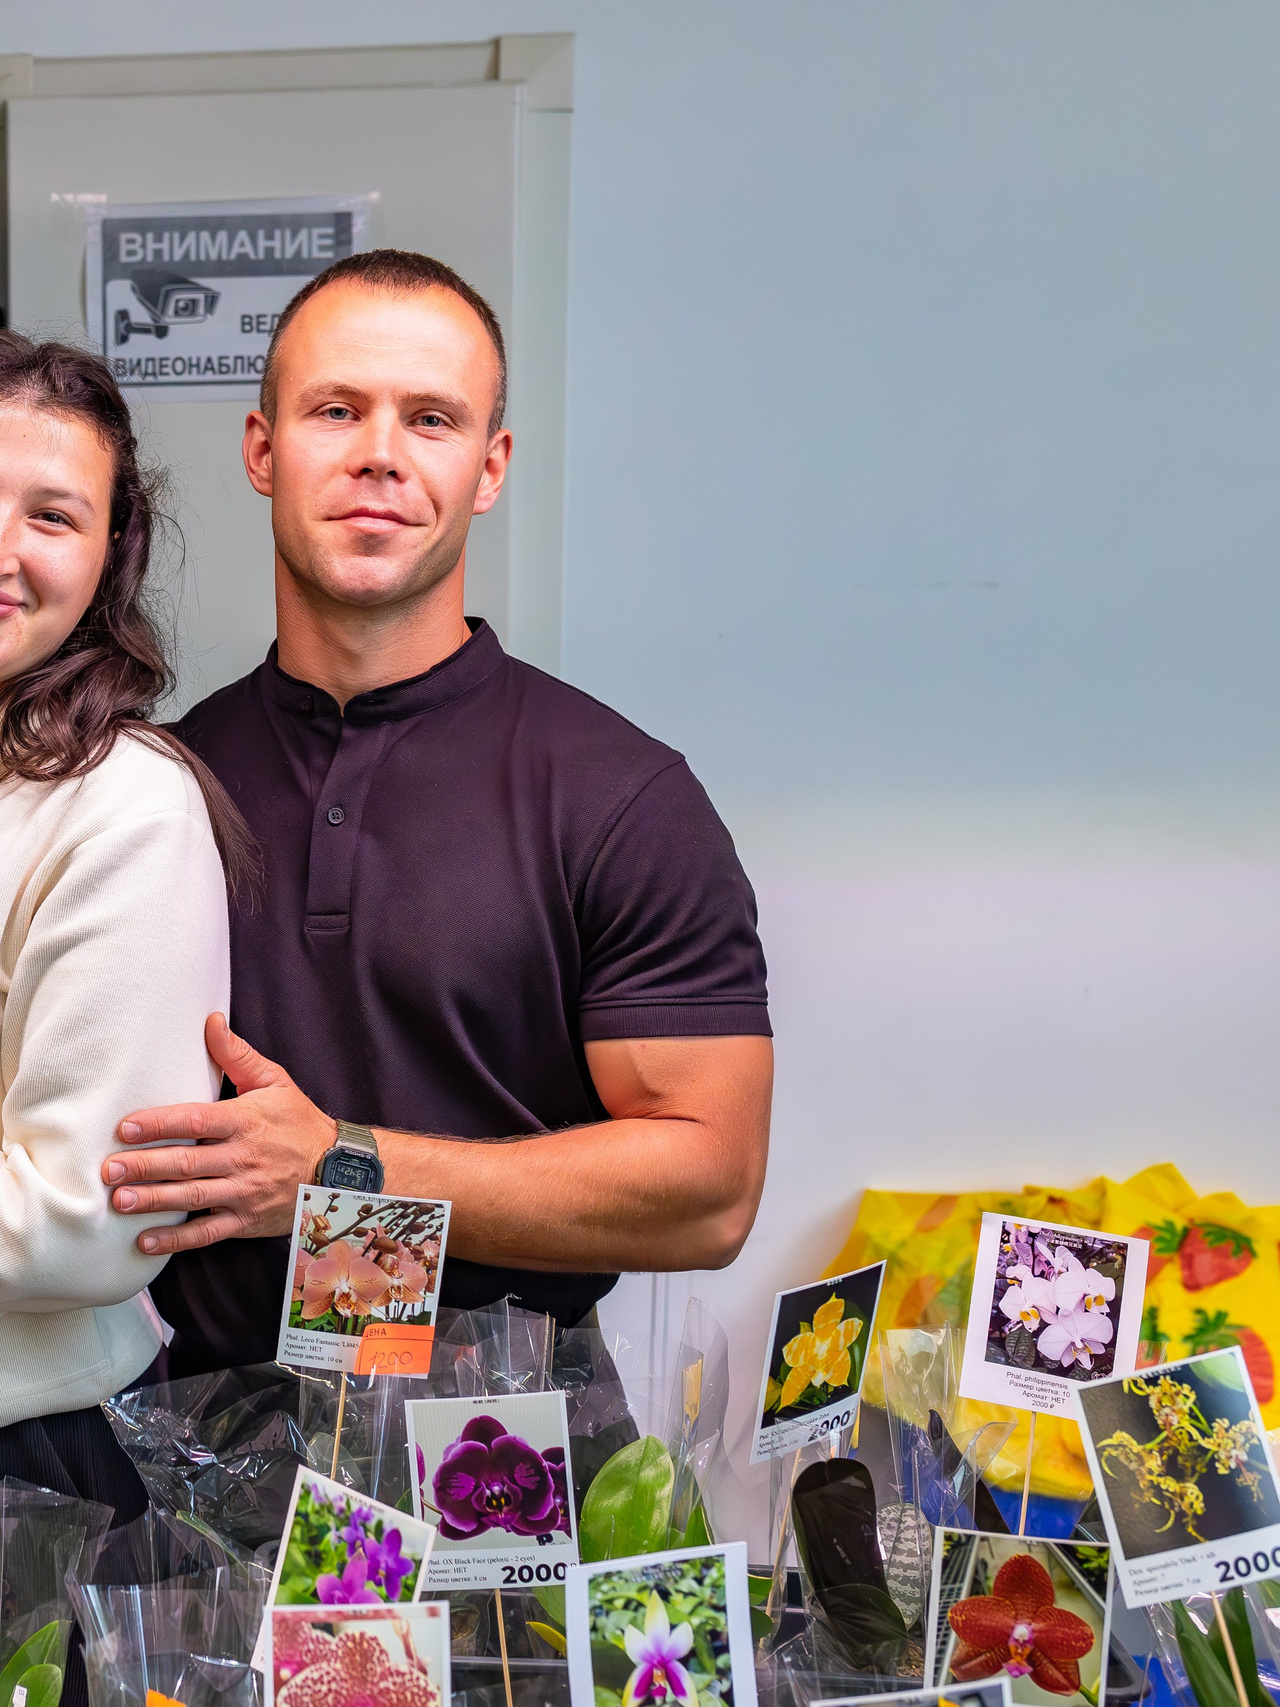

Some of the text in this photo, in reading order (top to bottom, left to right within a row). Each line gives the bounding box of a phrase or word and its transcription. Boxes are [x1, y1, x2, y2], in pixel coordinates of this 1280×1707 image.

[119, 226, 336, 264] ВНИМАНИЕ
[309, 1345, 323, 1353] НЕТ
[369, 1351, 413, 1369] 1200
[1006, 1371, 1068, 1390] Phal. philippinensis
[1009, 1380, 1034, 1390] Размер
[1031, 1400, 1049, 1409] 2000
[1051, 1396, 1066, 1404] НЕТ
[454, 1557, 470, 1565] Black
[428, 1576, 449, 1584] Размер
